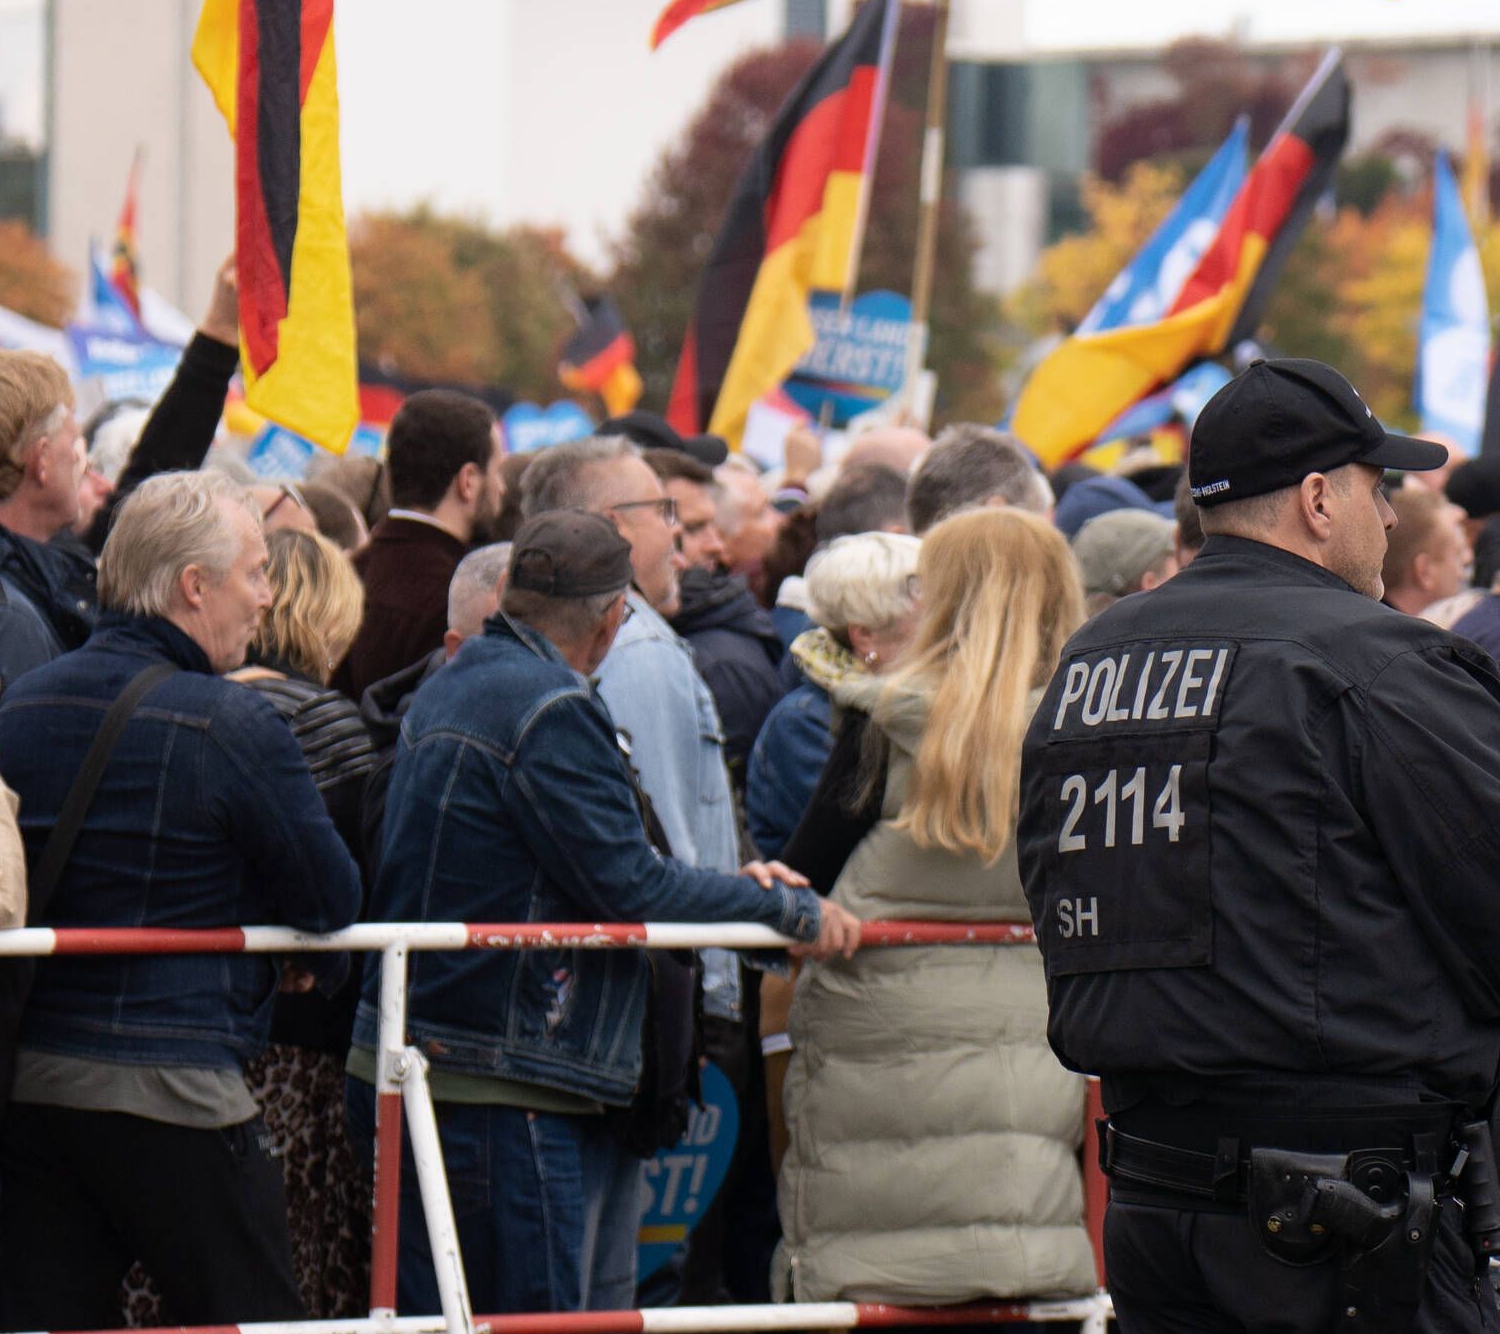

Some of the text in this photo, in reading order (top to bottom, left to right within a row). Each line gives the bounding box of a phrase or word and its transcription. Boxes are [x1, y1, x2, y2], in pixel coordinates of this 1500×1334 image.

[1054, 649, 1228, 730] POLIZEI
[1058, 765, 1186, 853] 2114
[1058, 897, 1098, 939] SH
